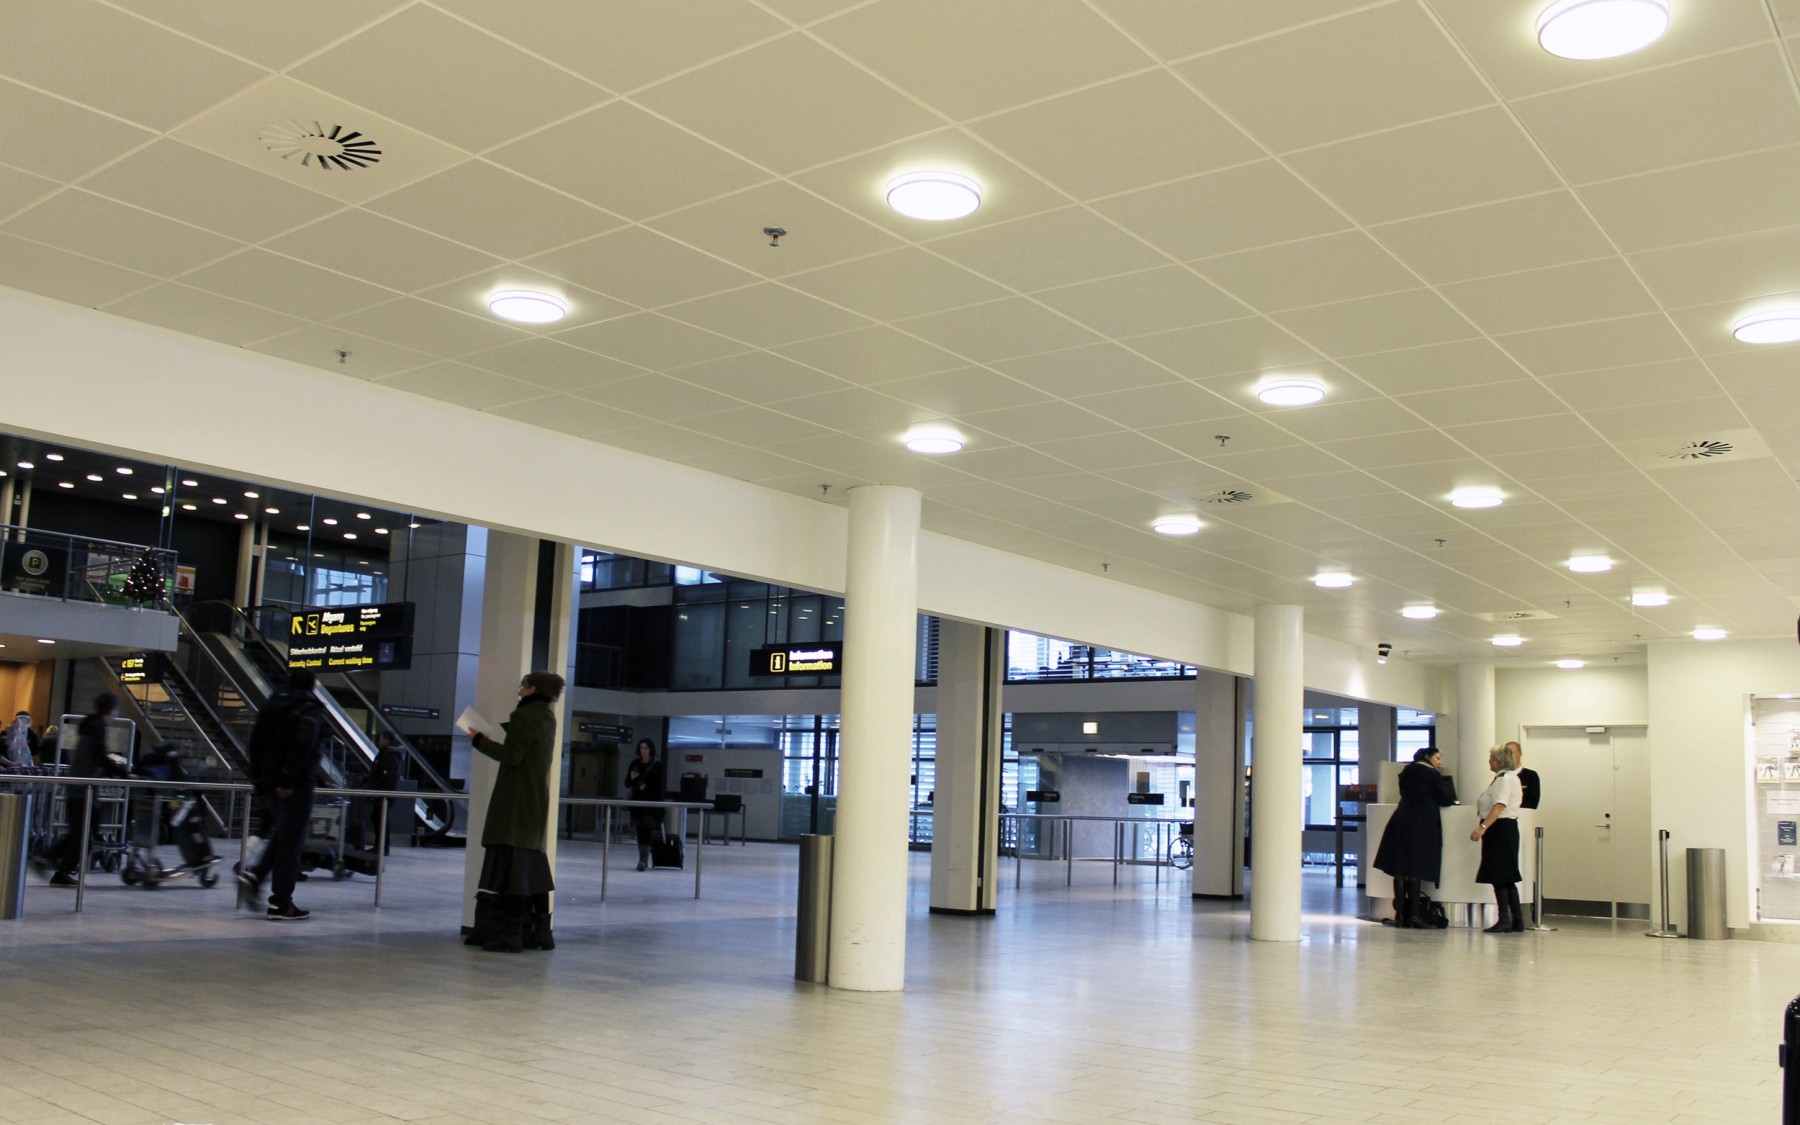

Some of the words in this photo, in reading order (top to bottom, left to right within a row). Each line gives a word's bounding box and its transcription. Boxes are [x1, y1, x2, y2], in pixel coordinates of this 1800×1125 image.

[322, 612, 345, 624] Afgang
[321, 624, 355, 635] Departures
[789, 649, 834, 660] Information
[289, 660, 305, 668] Security
[345, 657, 362, 665] waiting
[362, 656, 373, 664] time
[789, 660, 833, 671] Information
